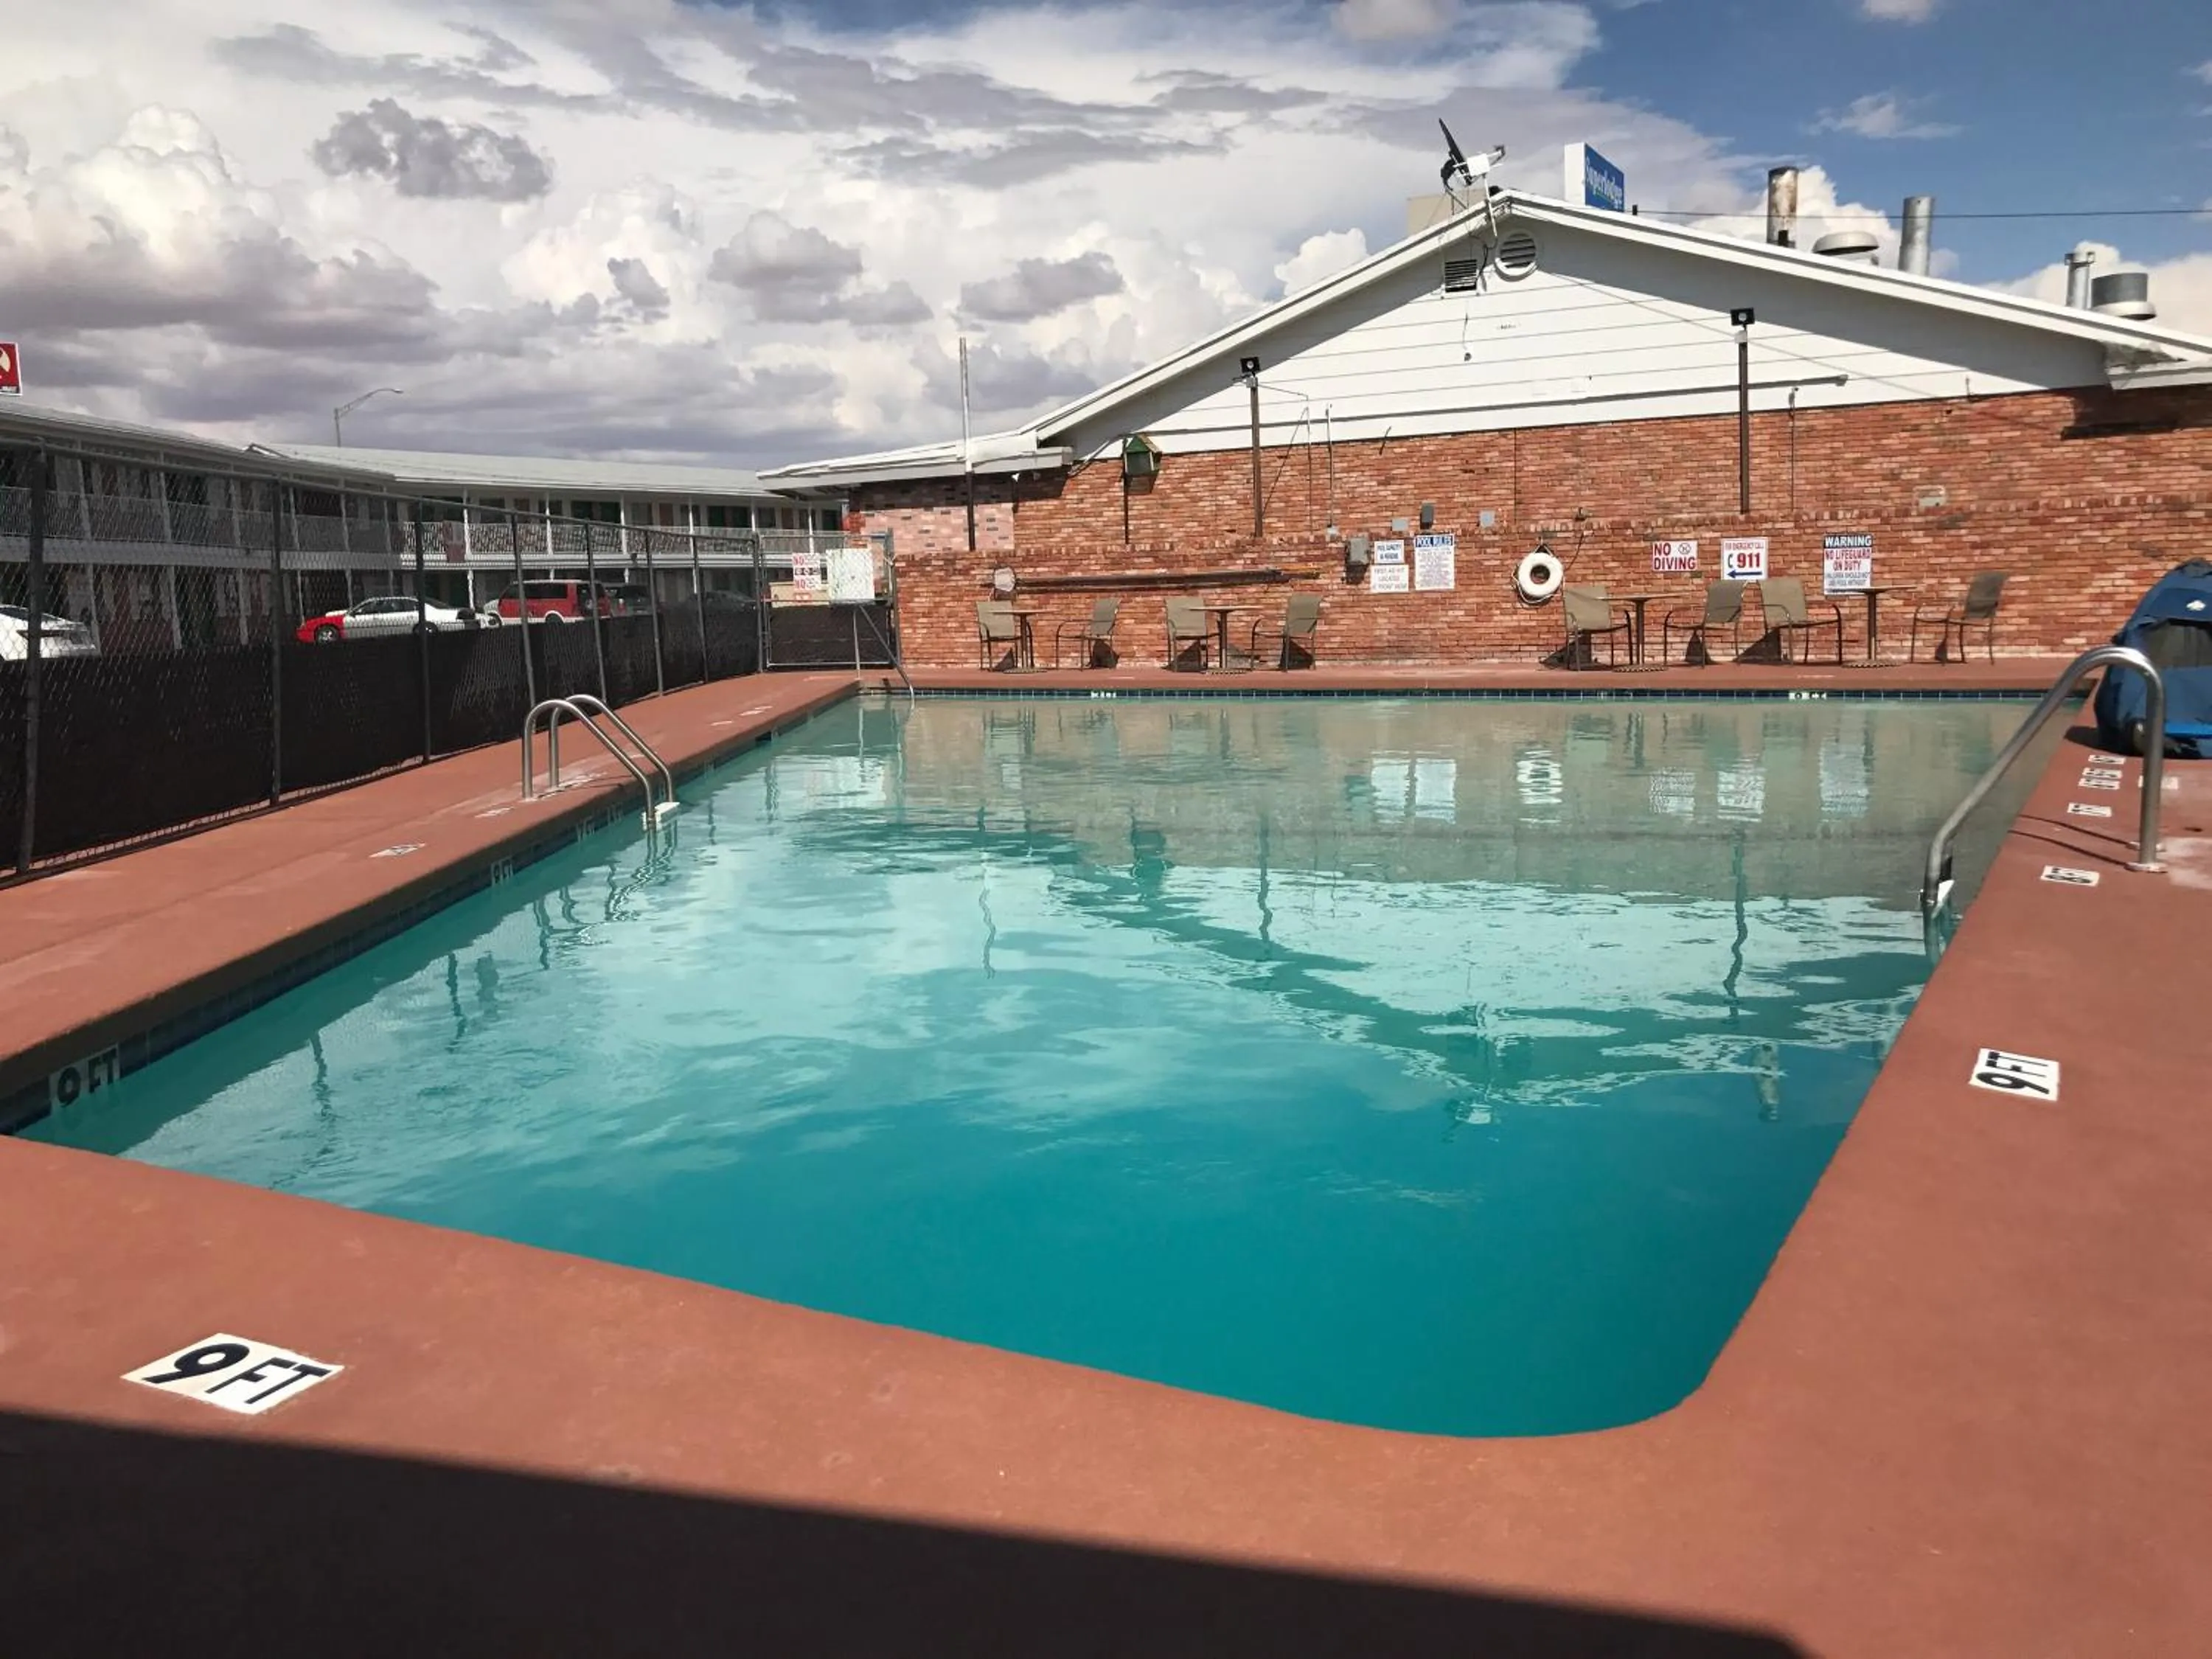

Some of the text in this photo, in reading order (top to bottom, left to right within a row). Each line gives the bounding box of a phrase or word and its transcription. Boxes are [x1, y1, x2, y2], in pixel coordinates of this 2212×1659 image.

[1825, 535, 1871, 547] WARNING
[1655, 543, 1672, 556] NO
[1826, 549, 1871, 560] NO LIFEGUARD
[1654, 557, 1696, 570] DIVING
[1737, 553, 1760, 568] 911
[1833, 560, 1861, 571] ON DUTY
[1976, 1051, 2050, 1095] 9 FT
[141, 1343, 332, 1405] 9 FT
